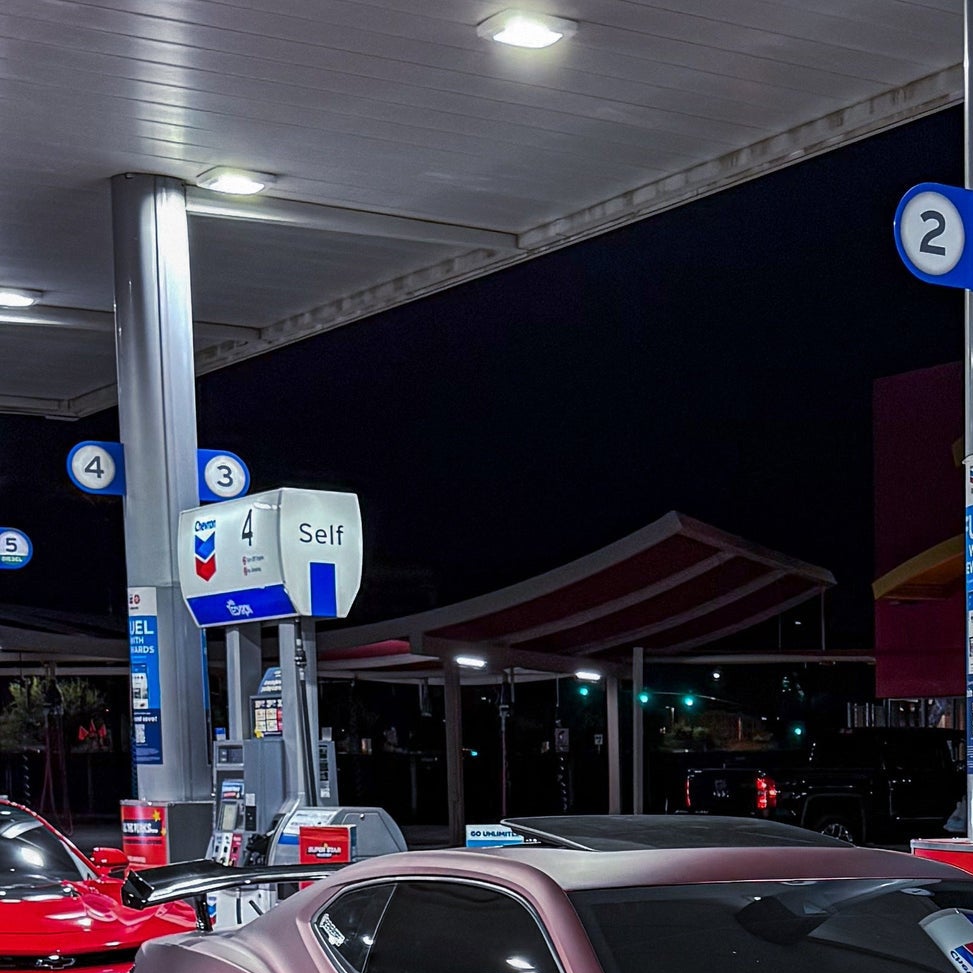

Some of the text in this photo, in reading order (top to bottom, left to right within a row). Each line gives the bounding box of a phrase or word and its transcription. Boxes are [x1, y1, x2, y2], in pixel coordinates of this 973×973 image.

[919, 209, 946, 256] 2
[84, 456, 105, 478] 4
[217, 465, 234, 487] 3
[242, 509, 253, 546] 4
[299, 523, 344, 545] Self
[6, 538, 17, 552] 5
[130, 620, 154, 634] UEL
